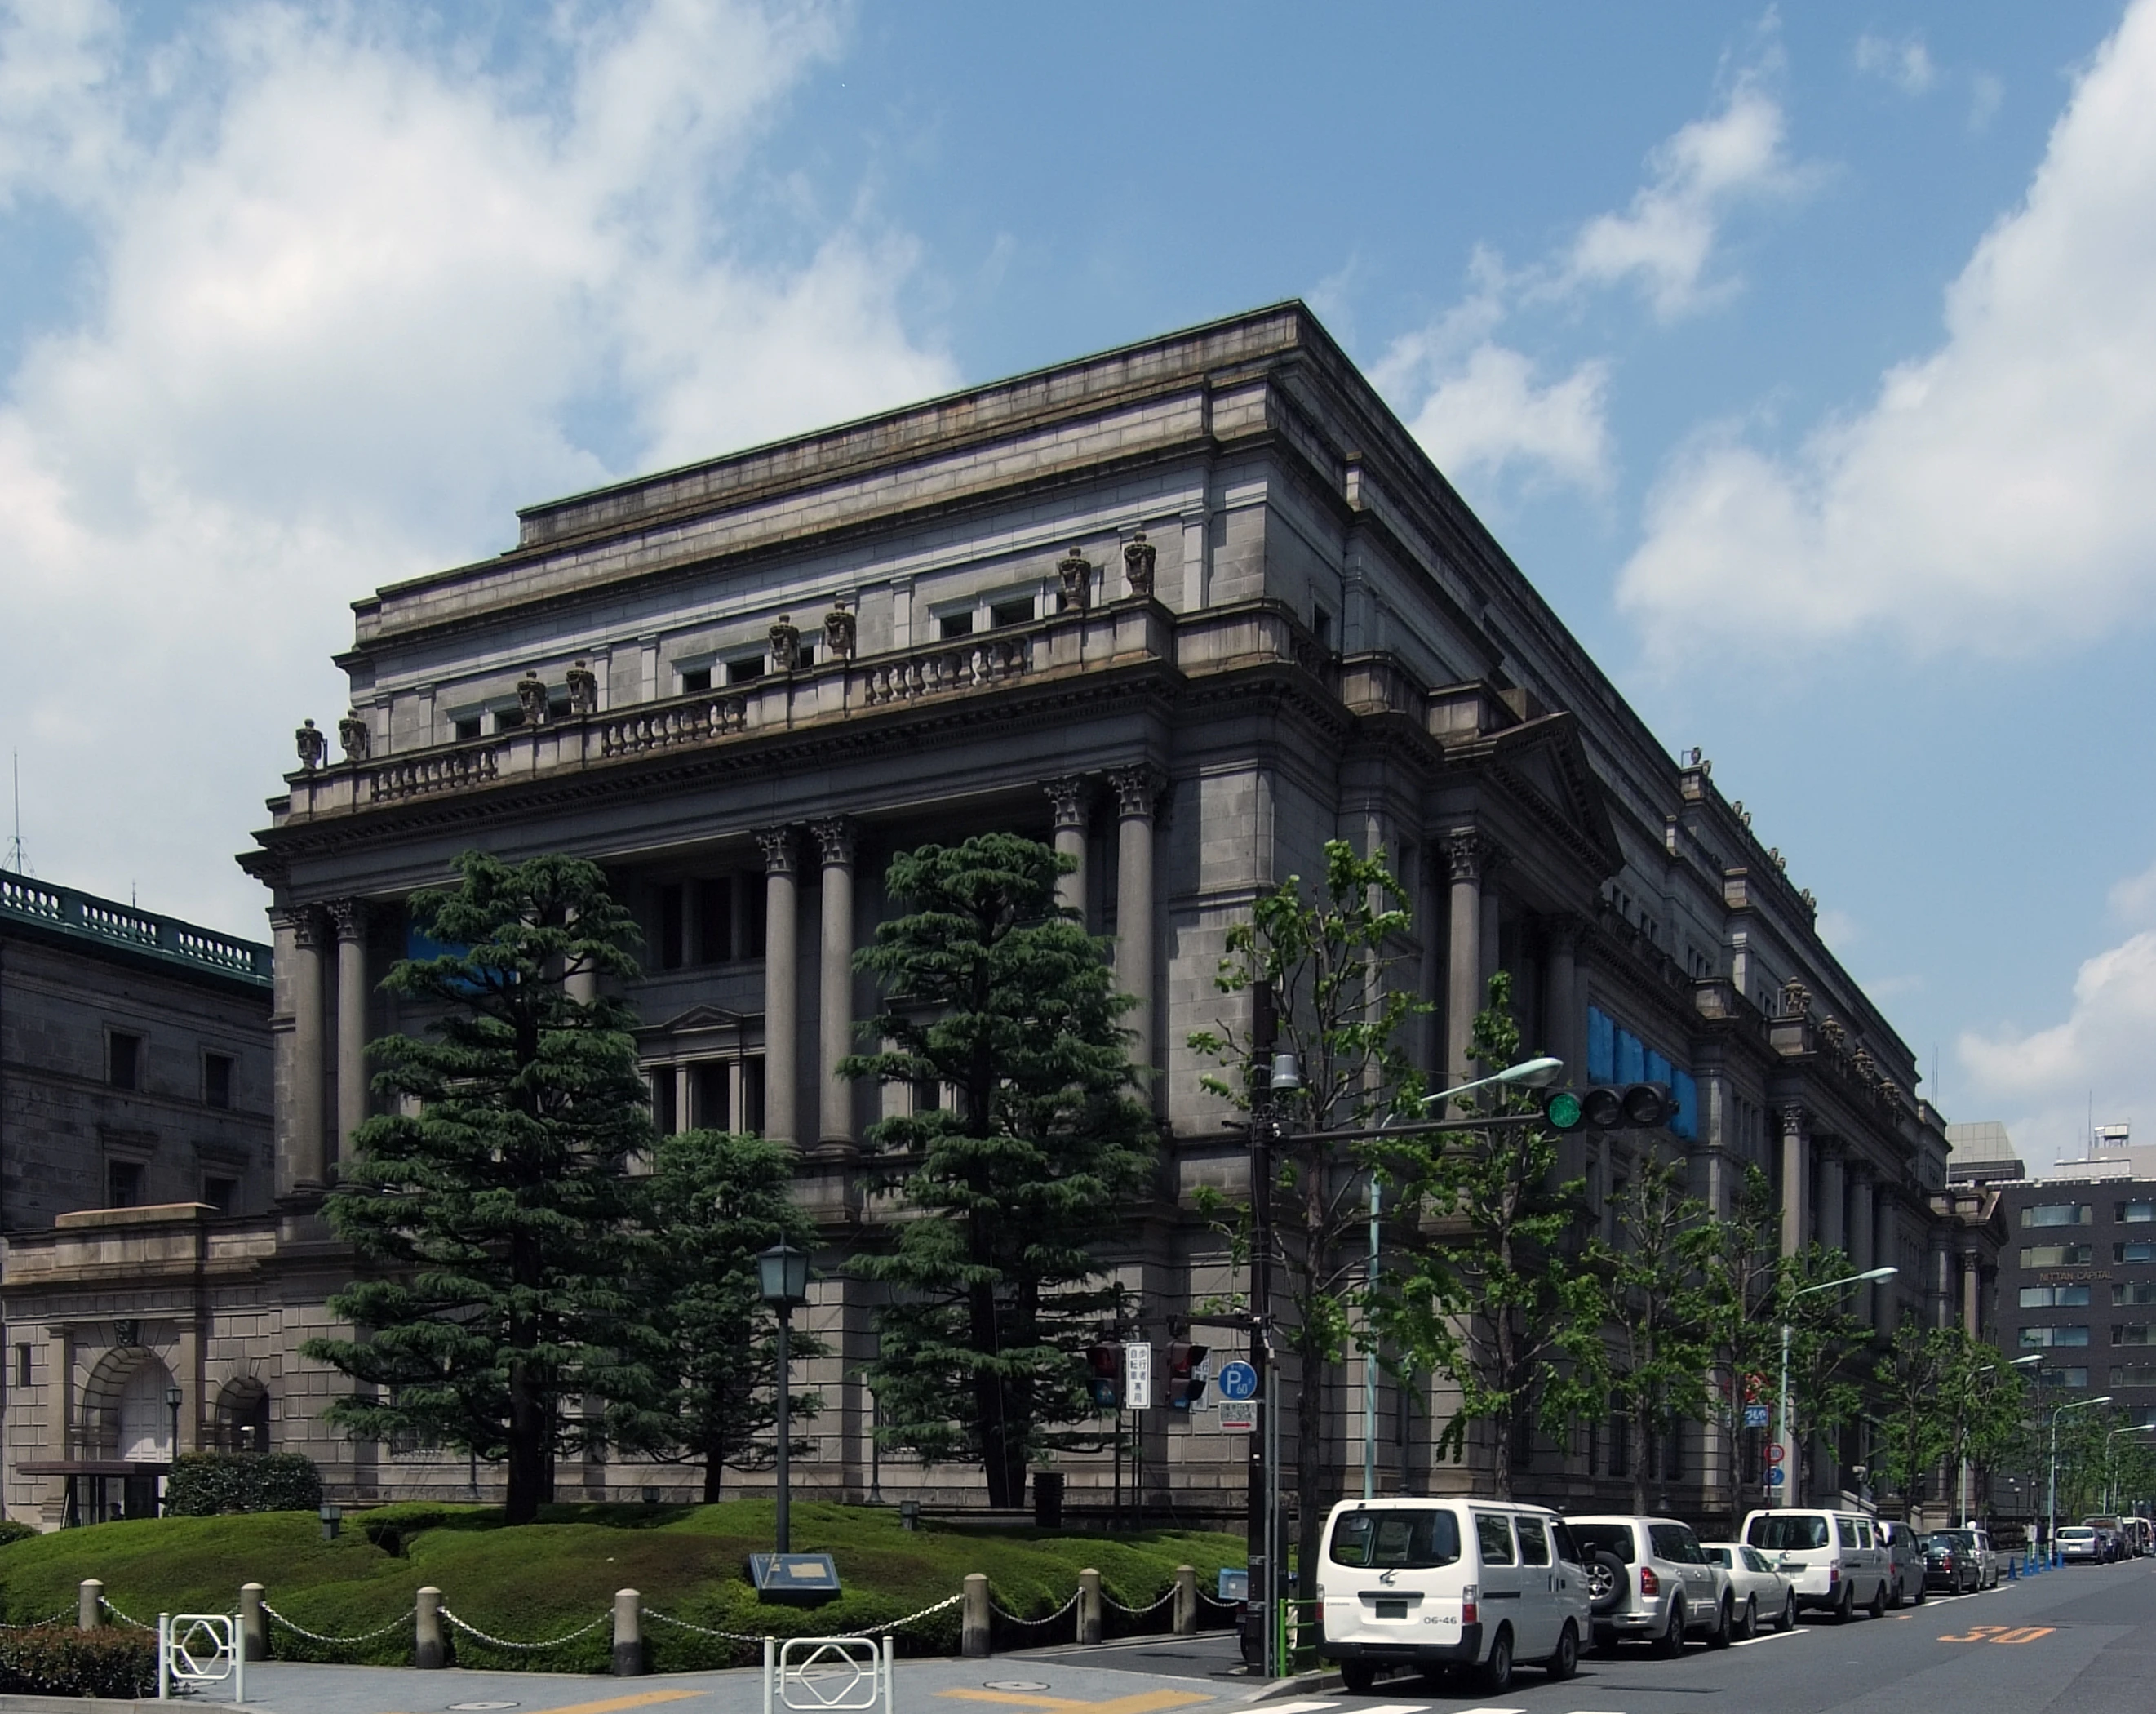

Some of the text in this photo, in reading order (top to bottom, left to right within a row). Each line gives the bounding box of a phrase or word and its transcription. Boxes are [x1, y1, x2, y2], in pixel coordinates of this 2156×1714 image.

[2040, 1270, 2113, 1281] NITTAN CAPITAL
[1227, 1370, 1242, 1395] P
[1236, 1383, 1248, 1395] 60
[1423, 1616, 1457, 1624] 06-46
[1936, 1626, 2056, 1643] 30
